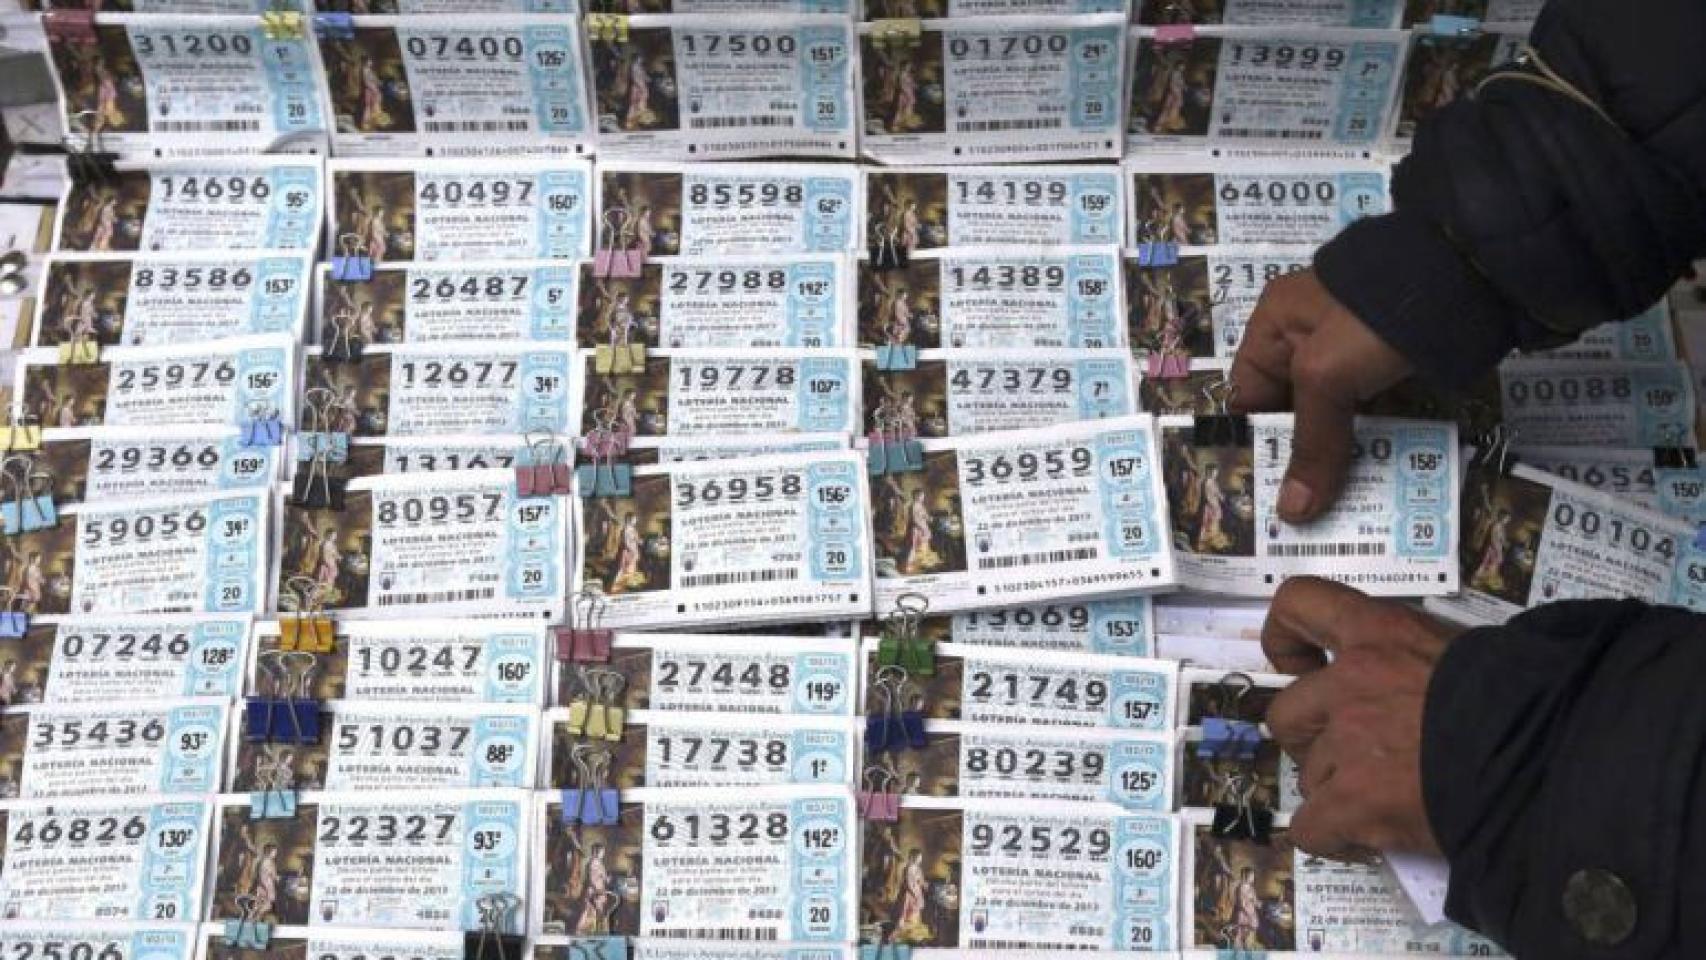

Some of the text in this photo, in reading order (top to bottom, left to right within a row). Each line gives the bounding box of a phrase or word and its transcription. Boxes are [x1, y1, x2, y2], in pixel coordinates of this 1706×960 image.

[135, 35, 249, 54] 31200
[408, 37, 523, 56] 07400
[683, 35, 795, 53] 17500
[951, 35, 1066, 56] 01700
[1232, 46, 1344, 67] 13999
[552, 108, 568, 119] 20
[817, 102, 834, 114] 20
[160, 177, 269, 198] 14696
[421, 182, 533, 202] 40497
[690, 184, 801, 204] 85598
[957, 181, 1065, 201] 14199
[1221, 182, 1333, 200] 64000
[135, 268, 250, 287] 83586
[669, 271, 784, 289] 27988
[953, 266, 1063, 287] 14389
[413, 277, 528, 298] 26487
[118, 362, 235, 389] 25976
[403, 363, 517, 383] 12677
[679, 367, 793, 386] 19778
[952, 369, 1071, 389] 47379
[1509, 378, 1630, 400] 00088
[97, 446, 218, 468] 29366
[965, 448, 1091, 484] 36959
[677, 475, 800, 507] 36958
[379, 494, 500, 522] 80957
[86, 511, 205, 544] 59056
[1123, 526, 1141, 540] 20
[1413, 524, 1434, 539] 20
[1556, 503, 1674, 558] 00104
[826, 552, 845, 564] 20
[523, 570, 541, 584] 20
[222, 587, 239, 599] 20
[64, 634, 189, 660] 07246
[359, 646, 482, 674] 10247
[659, 661, 790, 690] 27448
[412, 686, 474, 695] NACIONAL
[972, 673, 1106, 705] 21749
[718, 704, 781, 714] NACIONAL
[1032, 717, 1095, 727] NACIONAL
[34, 720, 164, 746] 35436
[339, 725, 470, 749] 51037
[657, 739, 786, 765] 17738
[396, 764, 460, 775] NACIONAL
[967, 750, 1104, 777] 80239
[14, 816, 146, 845] 46826
[320, 815, 455, 840] 22327
[651, 814, 787, 840] 61328
[972, 824, 1110, 857] 92529
[68, 855, 132, 864] NACIONAL
[385, 856, 451, 865] NACIONAL
[714, 856, 781, 865] NACIONAL
[1035, 869, 1100, 880] NACIONAL
[155, 904, 176, 919] 20
[811, 907, 830, 923] 20
[1132, 926, 1151, 942] 20
